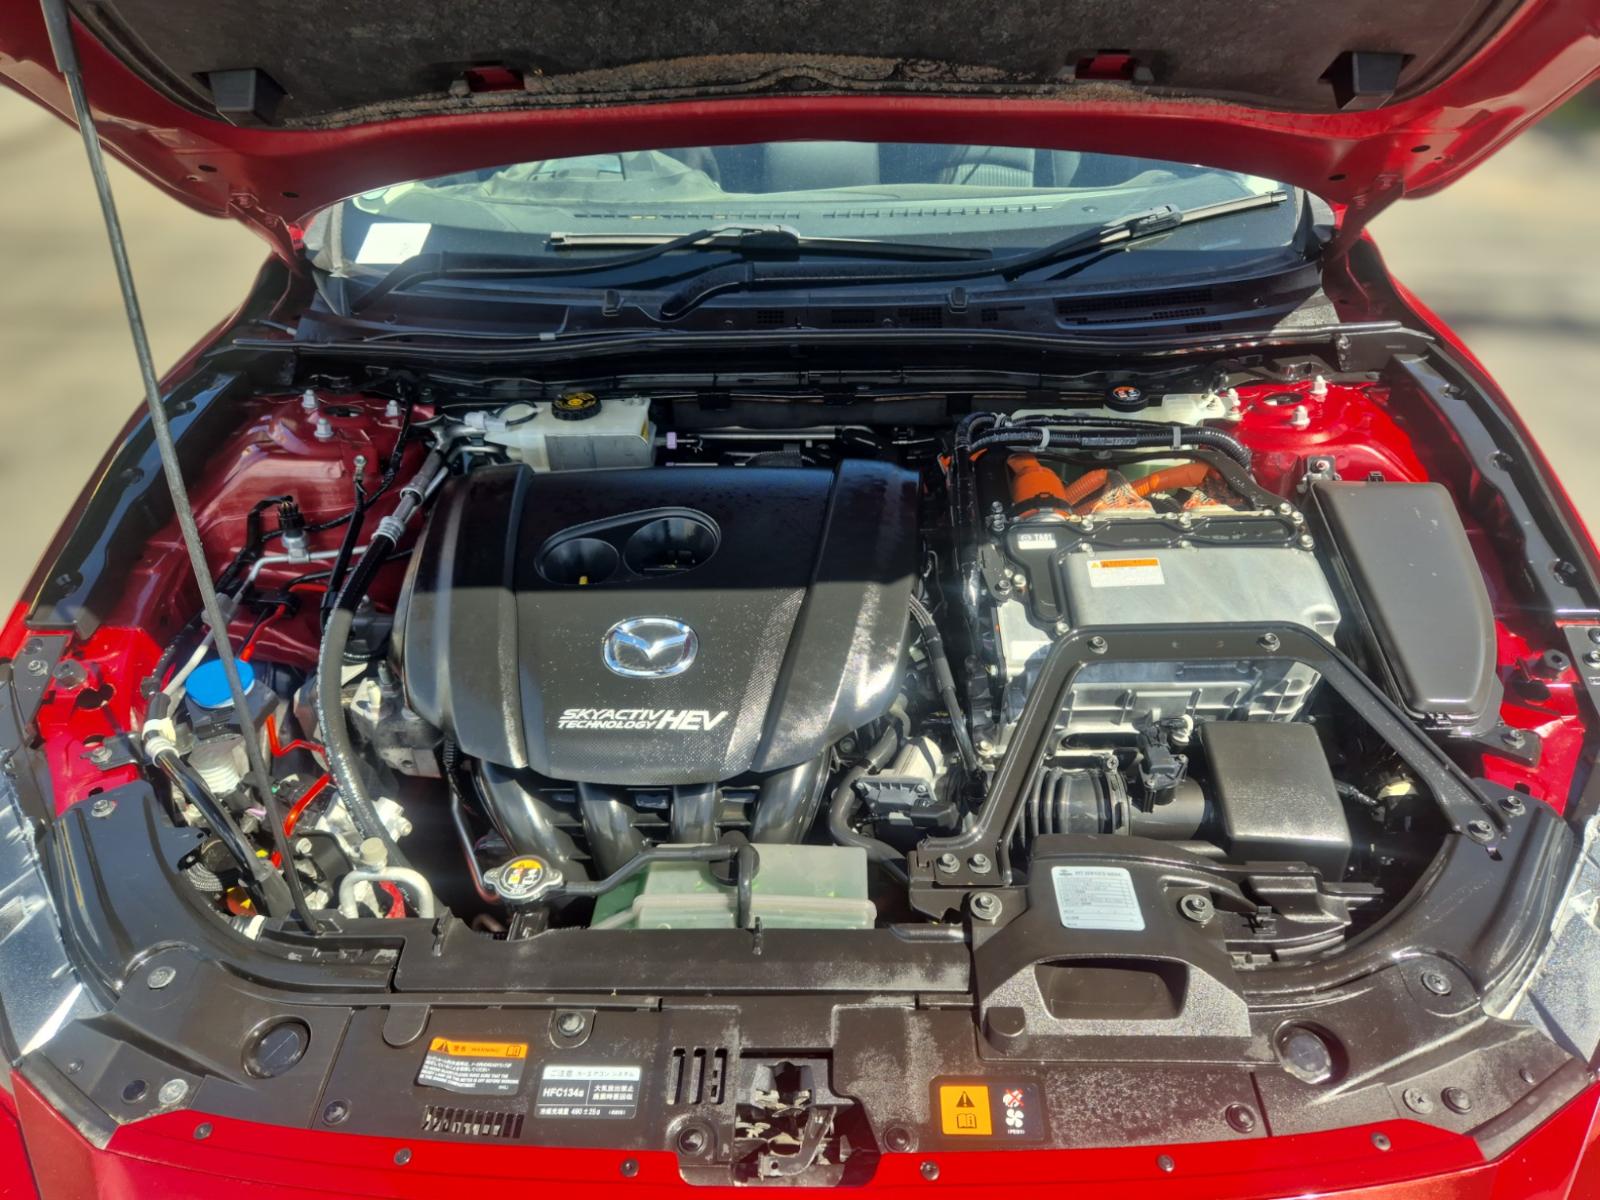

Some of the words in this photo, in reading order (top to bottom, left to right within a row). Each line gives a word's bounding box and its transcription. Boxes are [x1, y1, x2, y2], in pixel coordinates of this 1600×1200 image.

[559, 708, 665, 720] SKYACTIV
[558, 719, 658, 730] TECHNOLOGY
[655, 709, 729, 731] HEV
[542, 1087, 585, 1098] HFC134a
